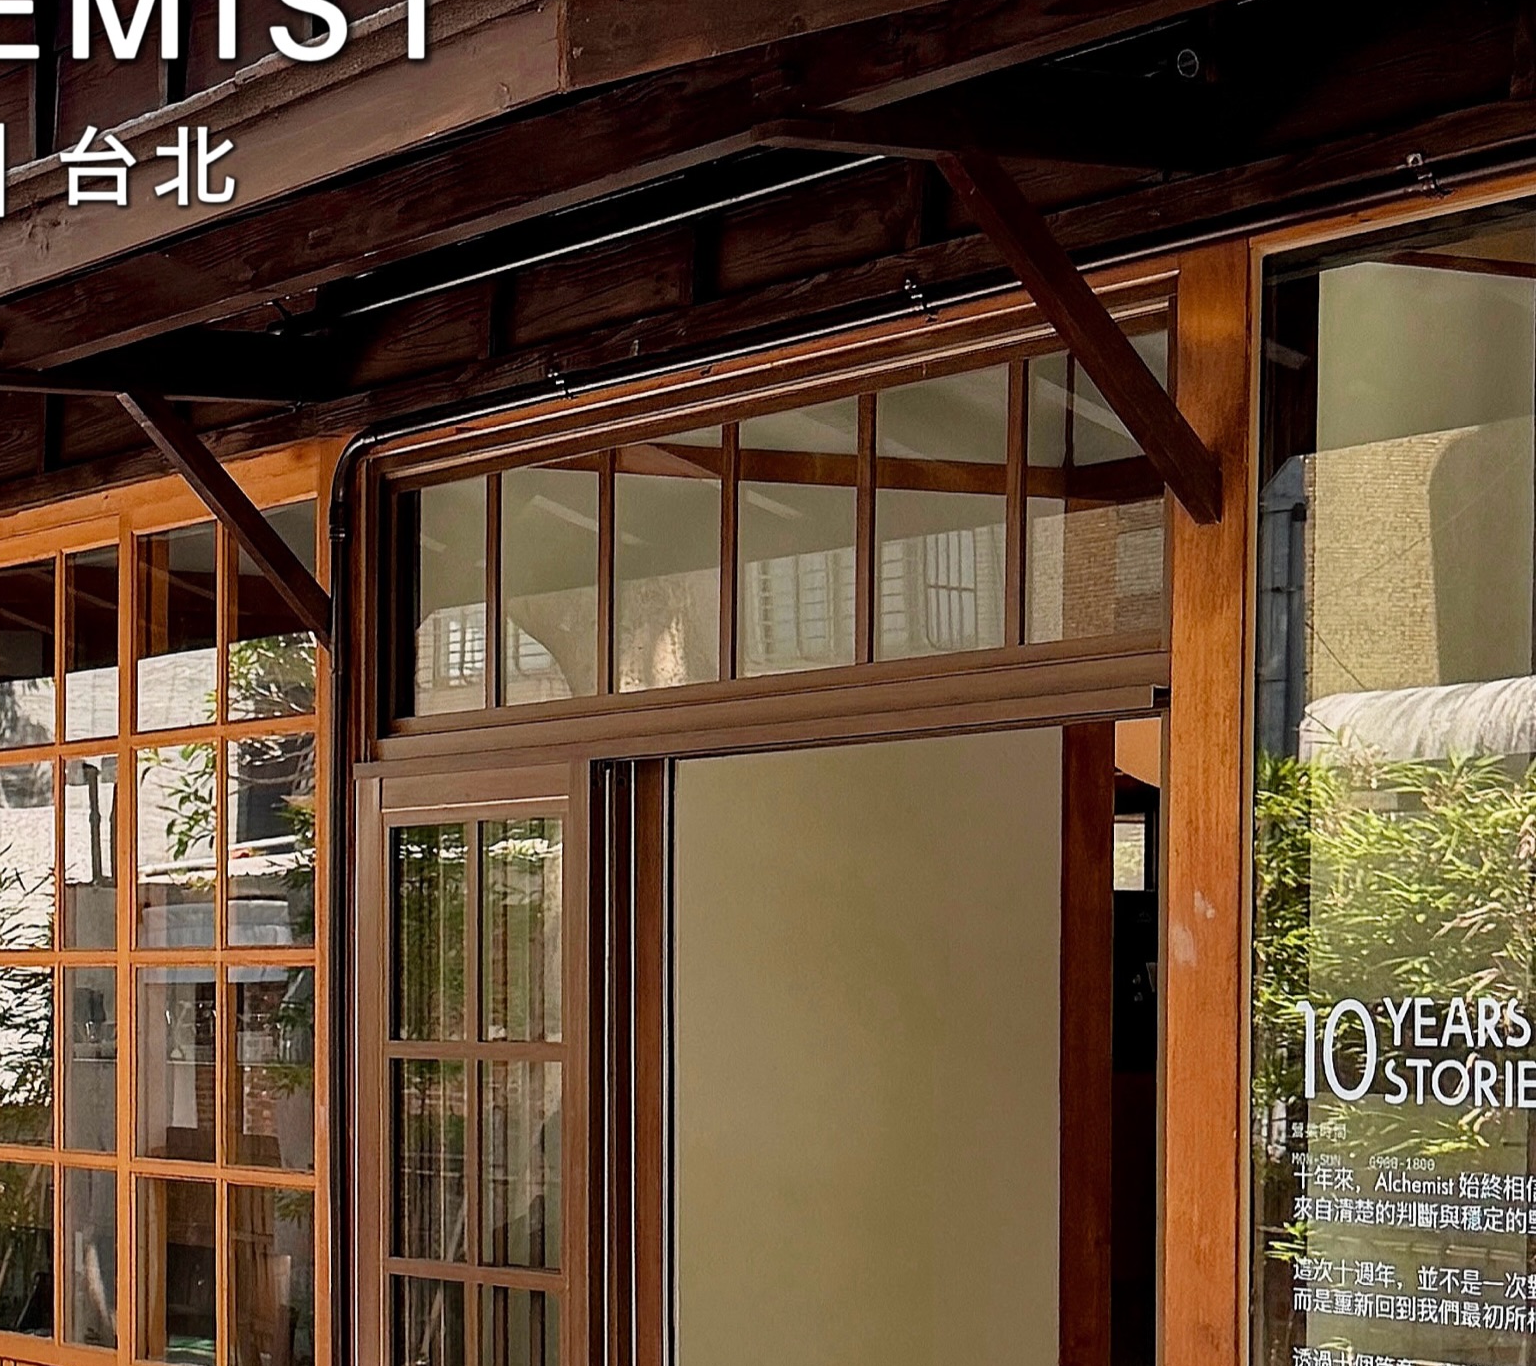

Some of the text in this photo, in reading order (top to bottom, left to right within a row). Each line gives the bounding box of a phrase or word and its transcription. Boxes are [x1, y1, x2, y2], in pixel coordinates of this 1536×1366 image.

[1295, 996, 1532, 1101] 10 YEARS
[1384, 1058, 1536, 1108] STORIE
[1374, 1170, 1455, 1195] Alchemist
